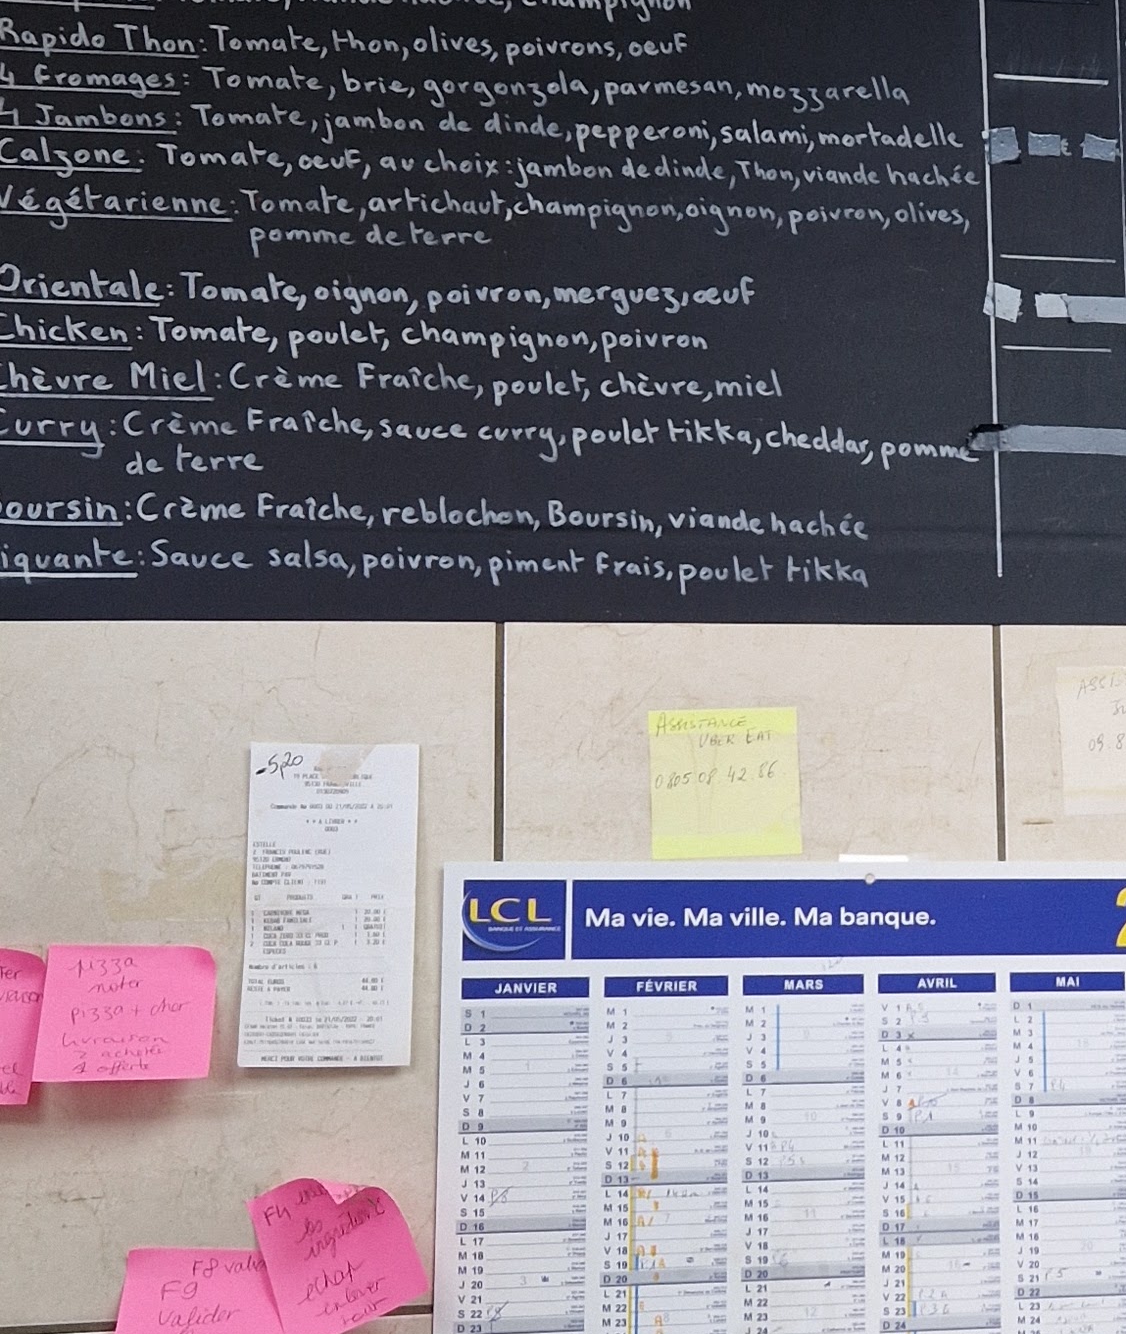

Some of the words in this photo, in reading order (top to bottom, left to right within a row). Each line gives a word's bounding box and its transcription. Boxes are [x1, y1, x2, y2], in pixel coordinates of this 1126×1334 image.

[0, 500, 132, 524] oursin:
[136, 493, 246, 522] Crème
[669, 511, 765, 534] viande
[770, 512, 869, 539] hachée
[469, 898, 552, 922] LCL
[585, 907, 628, 928] Ma
[632, 906, 677, 930] vie.
[684, 907, 728, 928] Ma
[732, 906, 787, 930] ville.
[794, 907, 836, 928] Ma
[840, 906, 936, 932] banque.
[495, 982, 557, 994] JANVIER
[636, 979, 697, 992] FÉVRIER
[784, 979, 823, 990] MARS
[918, 977, 957, 988] AVRIL
[1056, 976, 1079, 987] MAI
